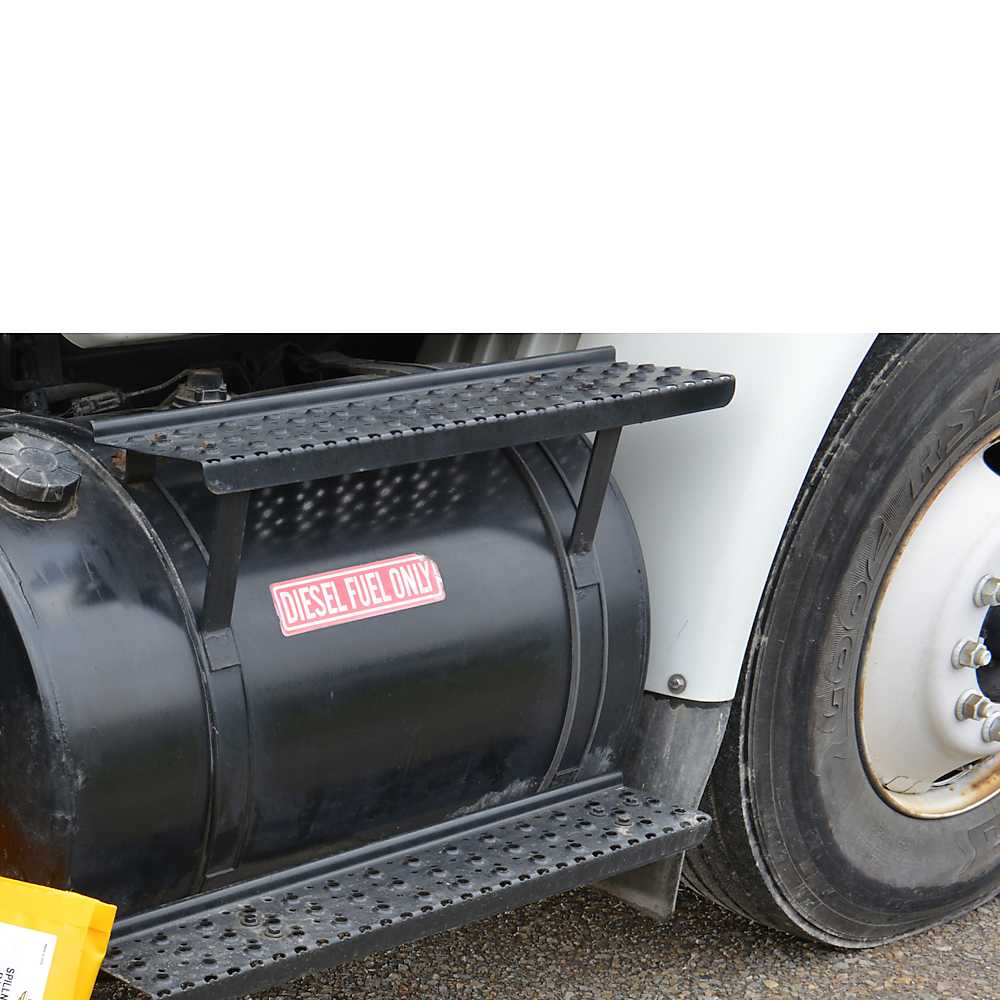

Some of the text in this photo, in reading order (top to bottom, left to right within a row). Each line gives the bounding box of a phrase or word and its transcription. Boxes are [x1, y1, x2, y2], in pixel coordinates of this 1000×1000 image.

[279, 560, 433, 624] DIESEL FUEL ONLY
